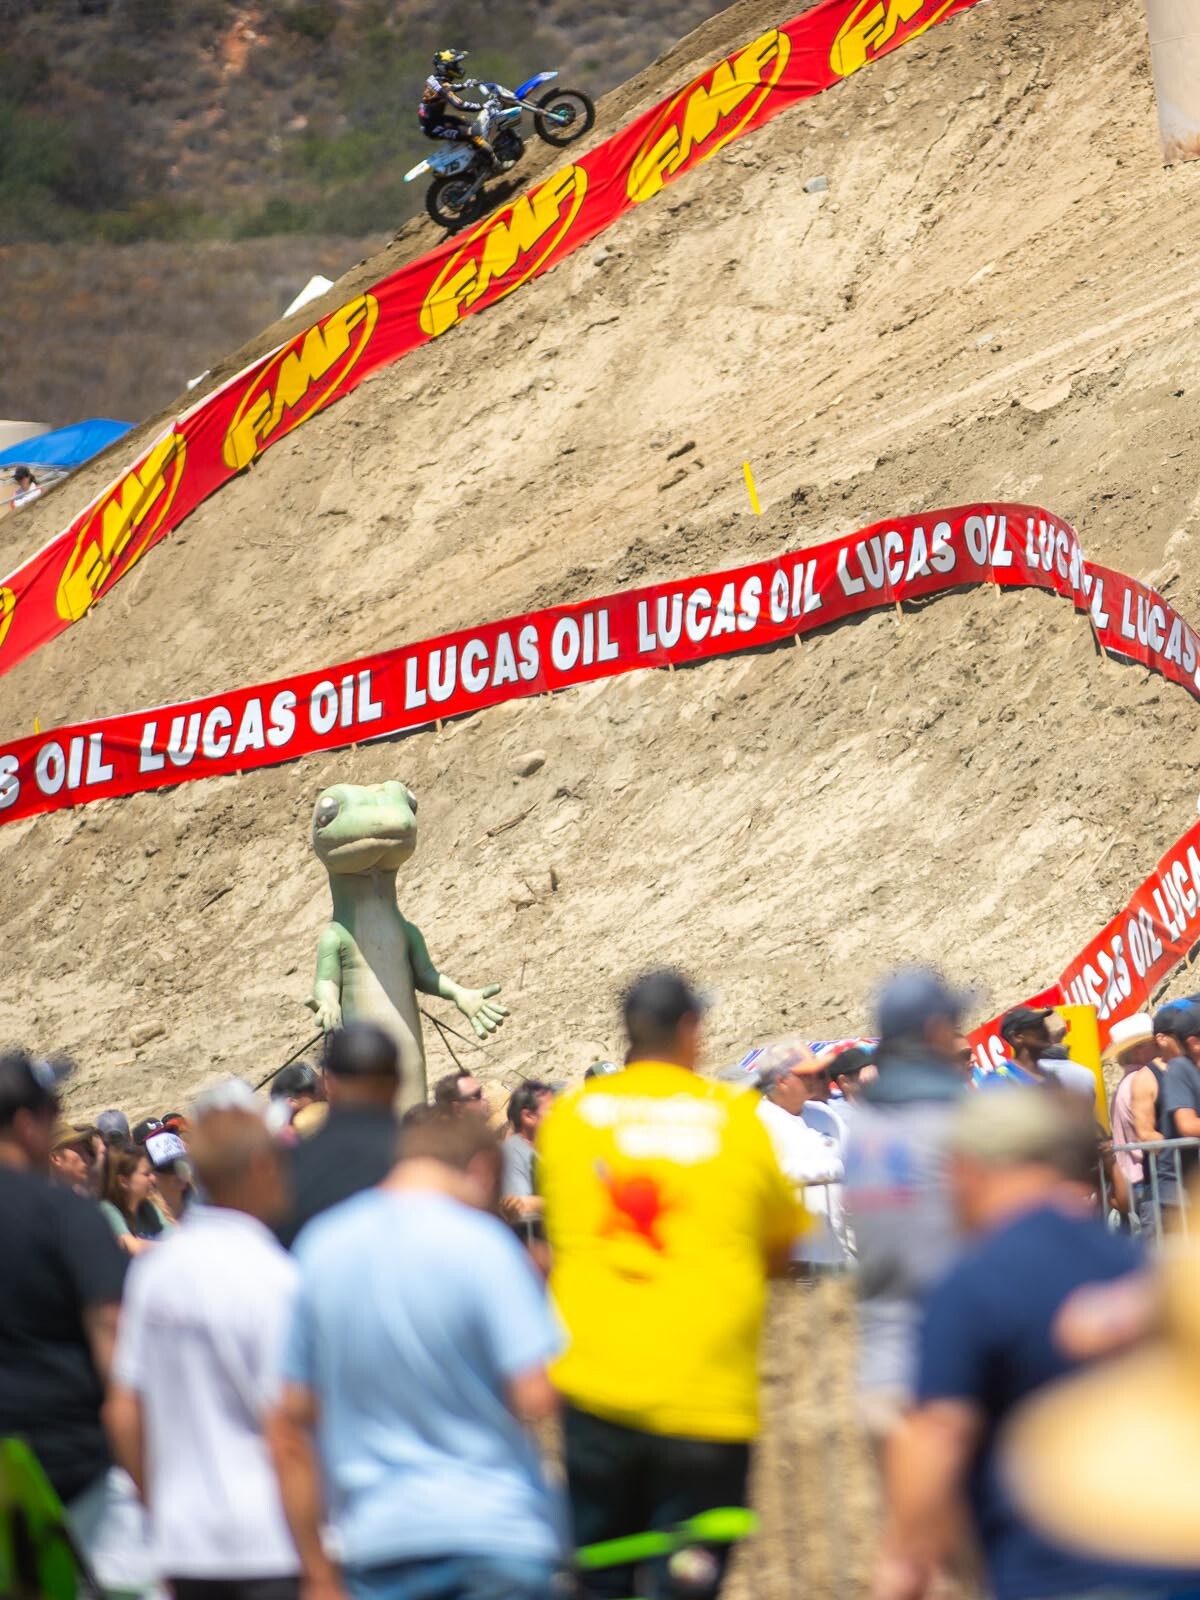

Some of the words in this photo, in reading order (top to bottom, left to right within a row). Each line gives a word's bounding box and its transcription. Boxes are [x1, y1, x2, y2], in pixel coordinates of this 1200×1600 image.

[632, 29, 779, 203] FMF
[429, 164, 577, 337] FMF
[231, 293, 369, 470] FMF
[62, 431, 178, 622] FMF
[35, 732, 114, 796] OIL
[139, 689, 296, 774] LUCAS
[309, 669, 383, 735] OIL
[404, 624, 540, 710] LUCAS
[551, 608, 619, 672] OIL
[638, 575, 760, 653] LUCAS
[769, 557, 822, 624] OIL
[837, 522, 956, 597] LUCAS
[965, 514, 1013, 568] OIL
[1026, 517, 1084, 590] LUCA
[1121, 588, 1198, 674] LUCAS
[1127, 906, 1162, 979] OIL
